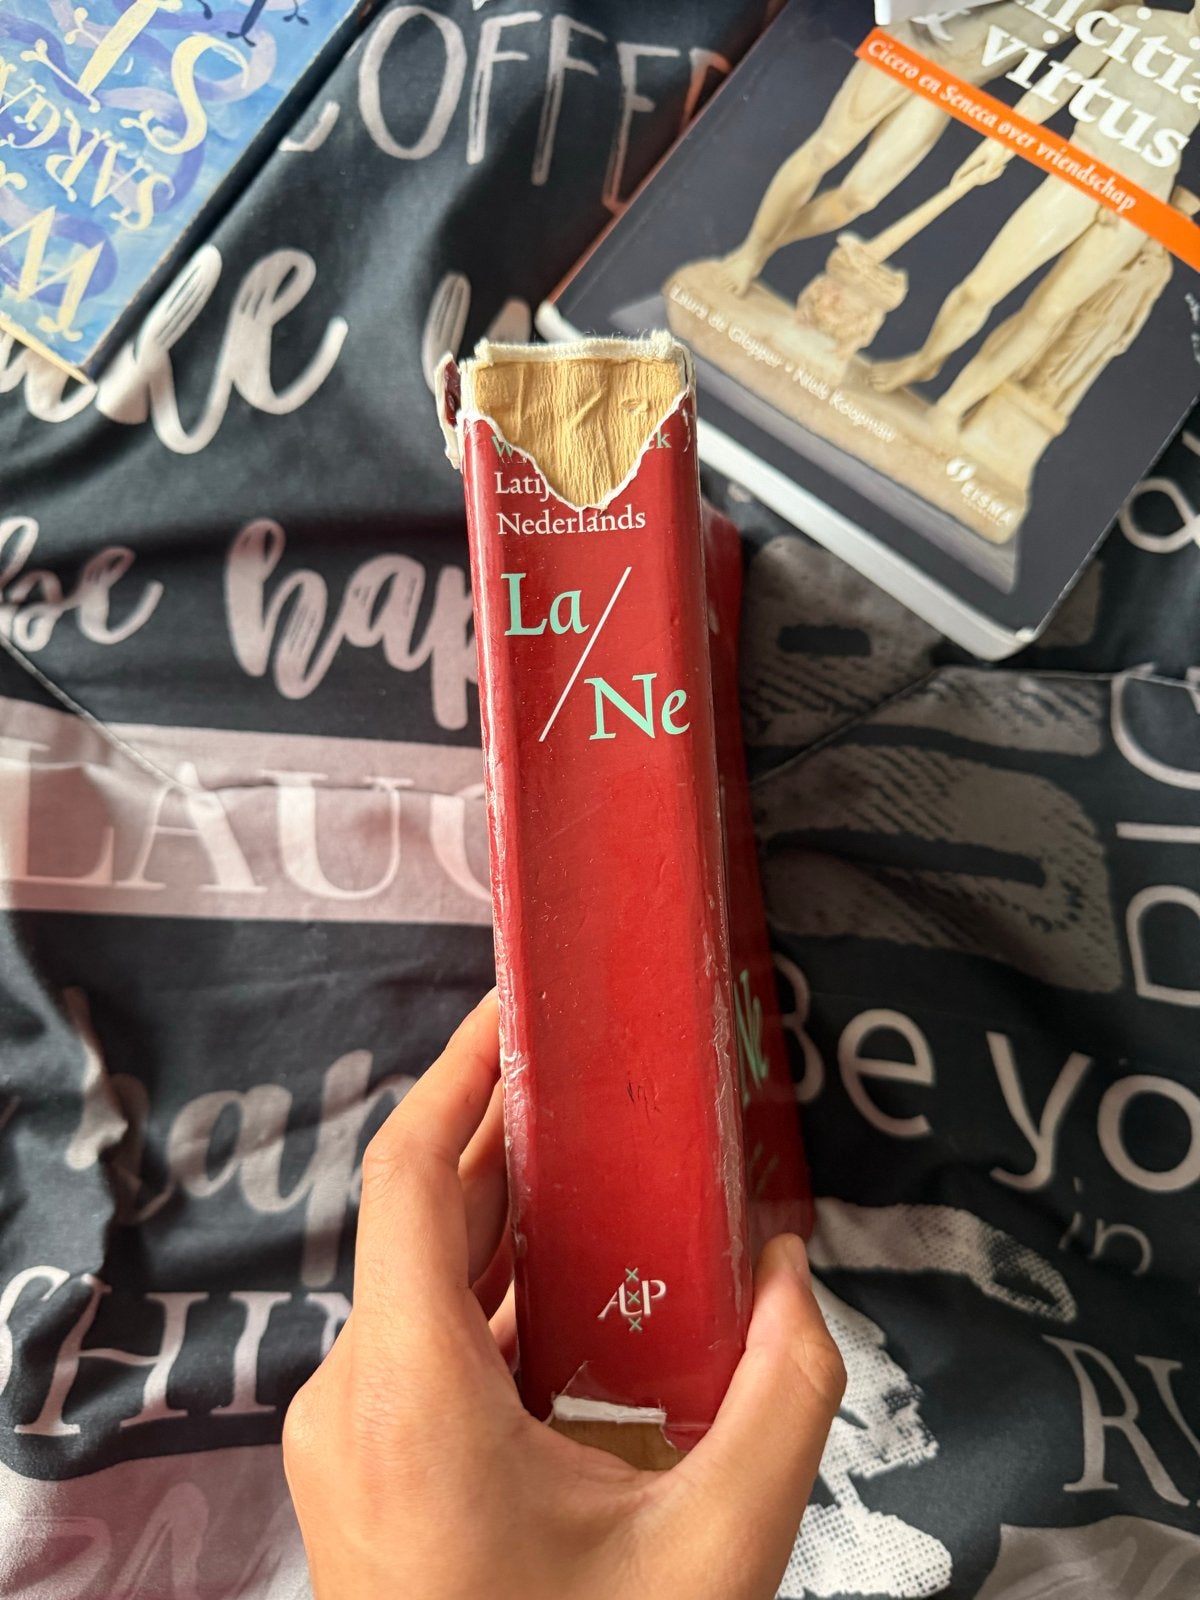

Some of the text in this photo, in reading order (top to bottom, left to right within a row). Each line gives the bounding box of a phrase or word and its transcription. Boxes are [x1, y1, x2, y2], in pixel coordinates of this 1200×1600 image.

[277, 4, 733, 213] OFFE
[866, 39, 1138, 214] Cicero en Seneca over vriendschap
[981, 24, 1191, 168] virtus
[493, 471, 550, 502] Latij
[496, 503, 647, 536] Nederlands
[501, 572, 590, 637] La
[584, 673, 691, 741] Ne
